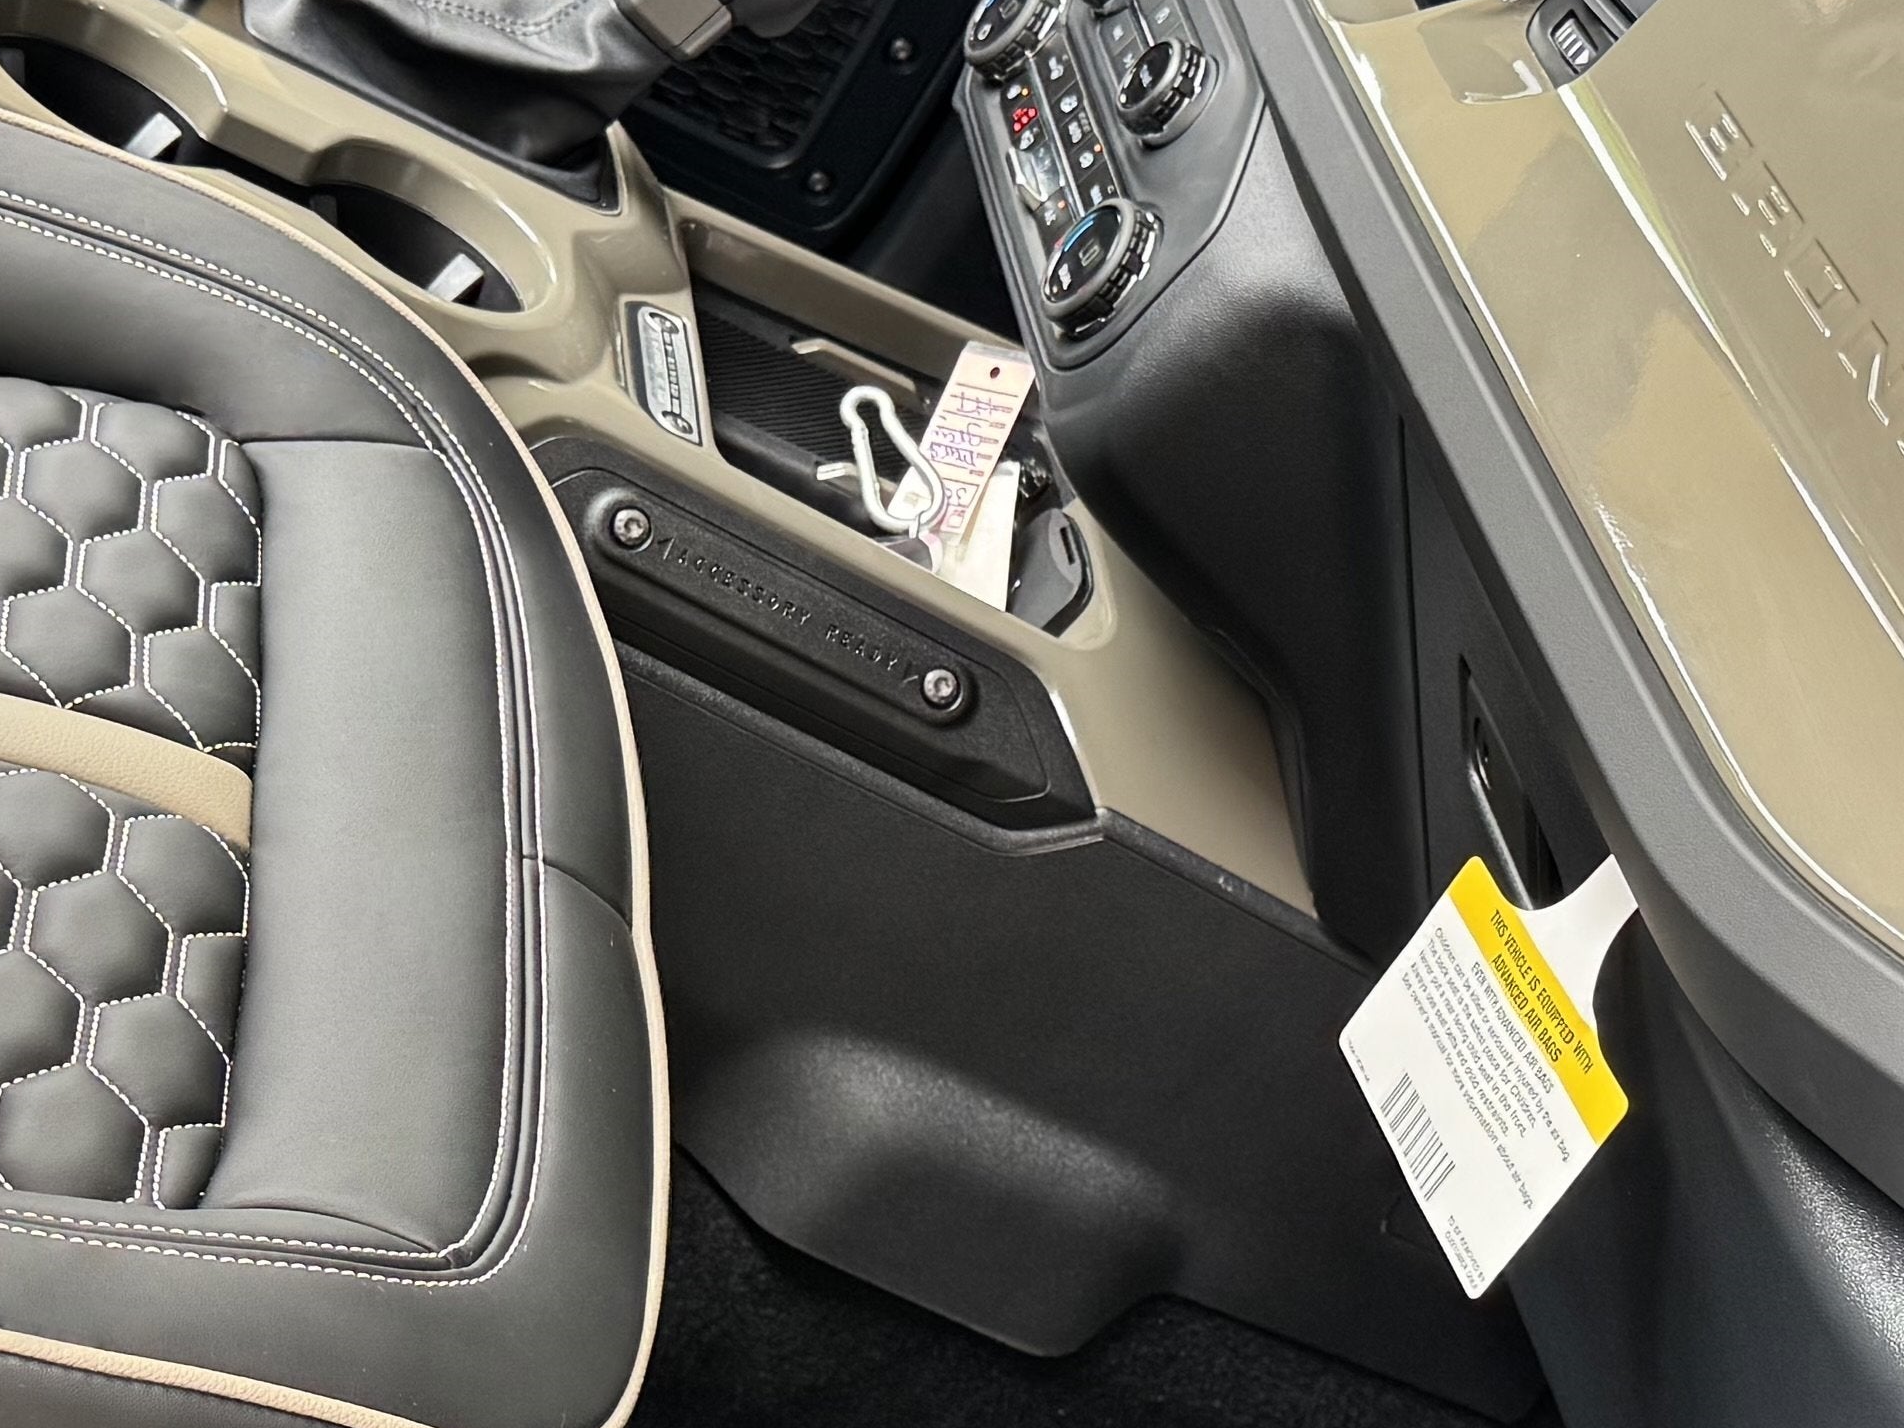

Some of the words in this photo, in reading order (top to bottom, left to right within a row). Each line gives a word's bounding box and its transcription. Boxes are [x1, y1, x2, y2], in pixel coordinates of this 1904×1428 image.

[677, 548, 811, 626] ACCESSORY
[825, 623, 897, 672] READY
[1470, 960, 1487, 986] EVEN
[1483, 983, 1499, 1008] WITH
[1494, 1005, 1527, 1053] ADVANCED
[1522, 1050, 1539, 1070] AIR
[1533, 1065, 1554, 1094] BAGS
[1489, 908, 1509, 938] THIS
[1503, 931, 1533, 980] VEHICLE
[1526, 974, 1541, 992] IS
[1535, 986, 1575, 1044] EQUIPPED
[1572, 1039, 1594, 1074] WITH
[1490, 952, 1529, 1011] ADVANCED
[1523, 1007, 1543, 1032] AIR
[1536, 1026, 1562, 1062] BAGS
